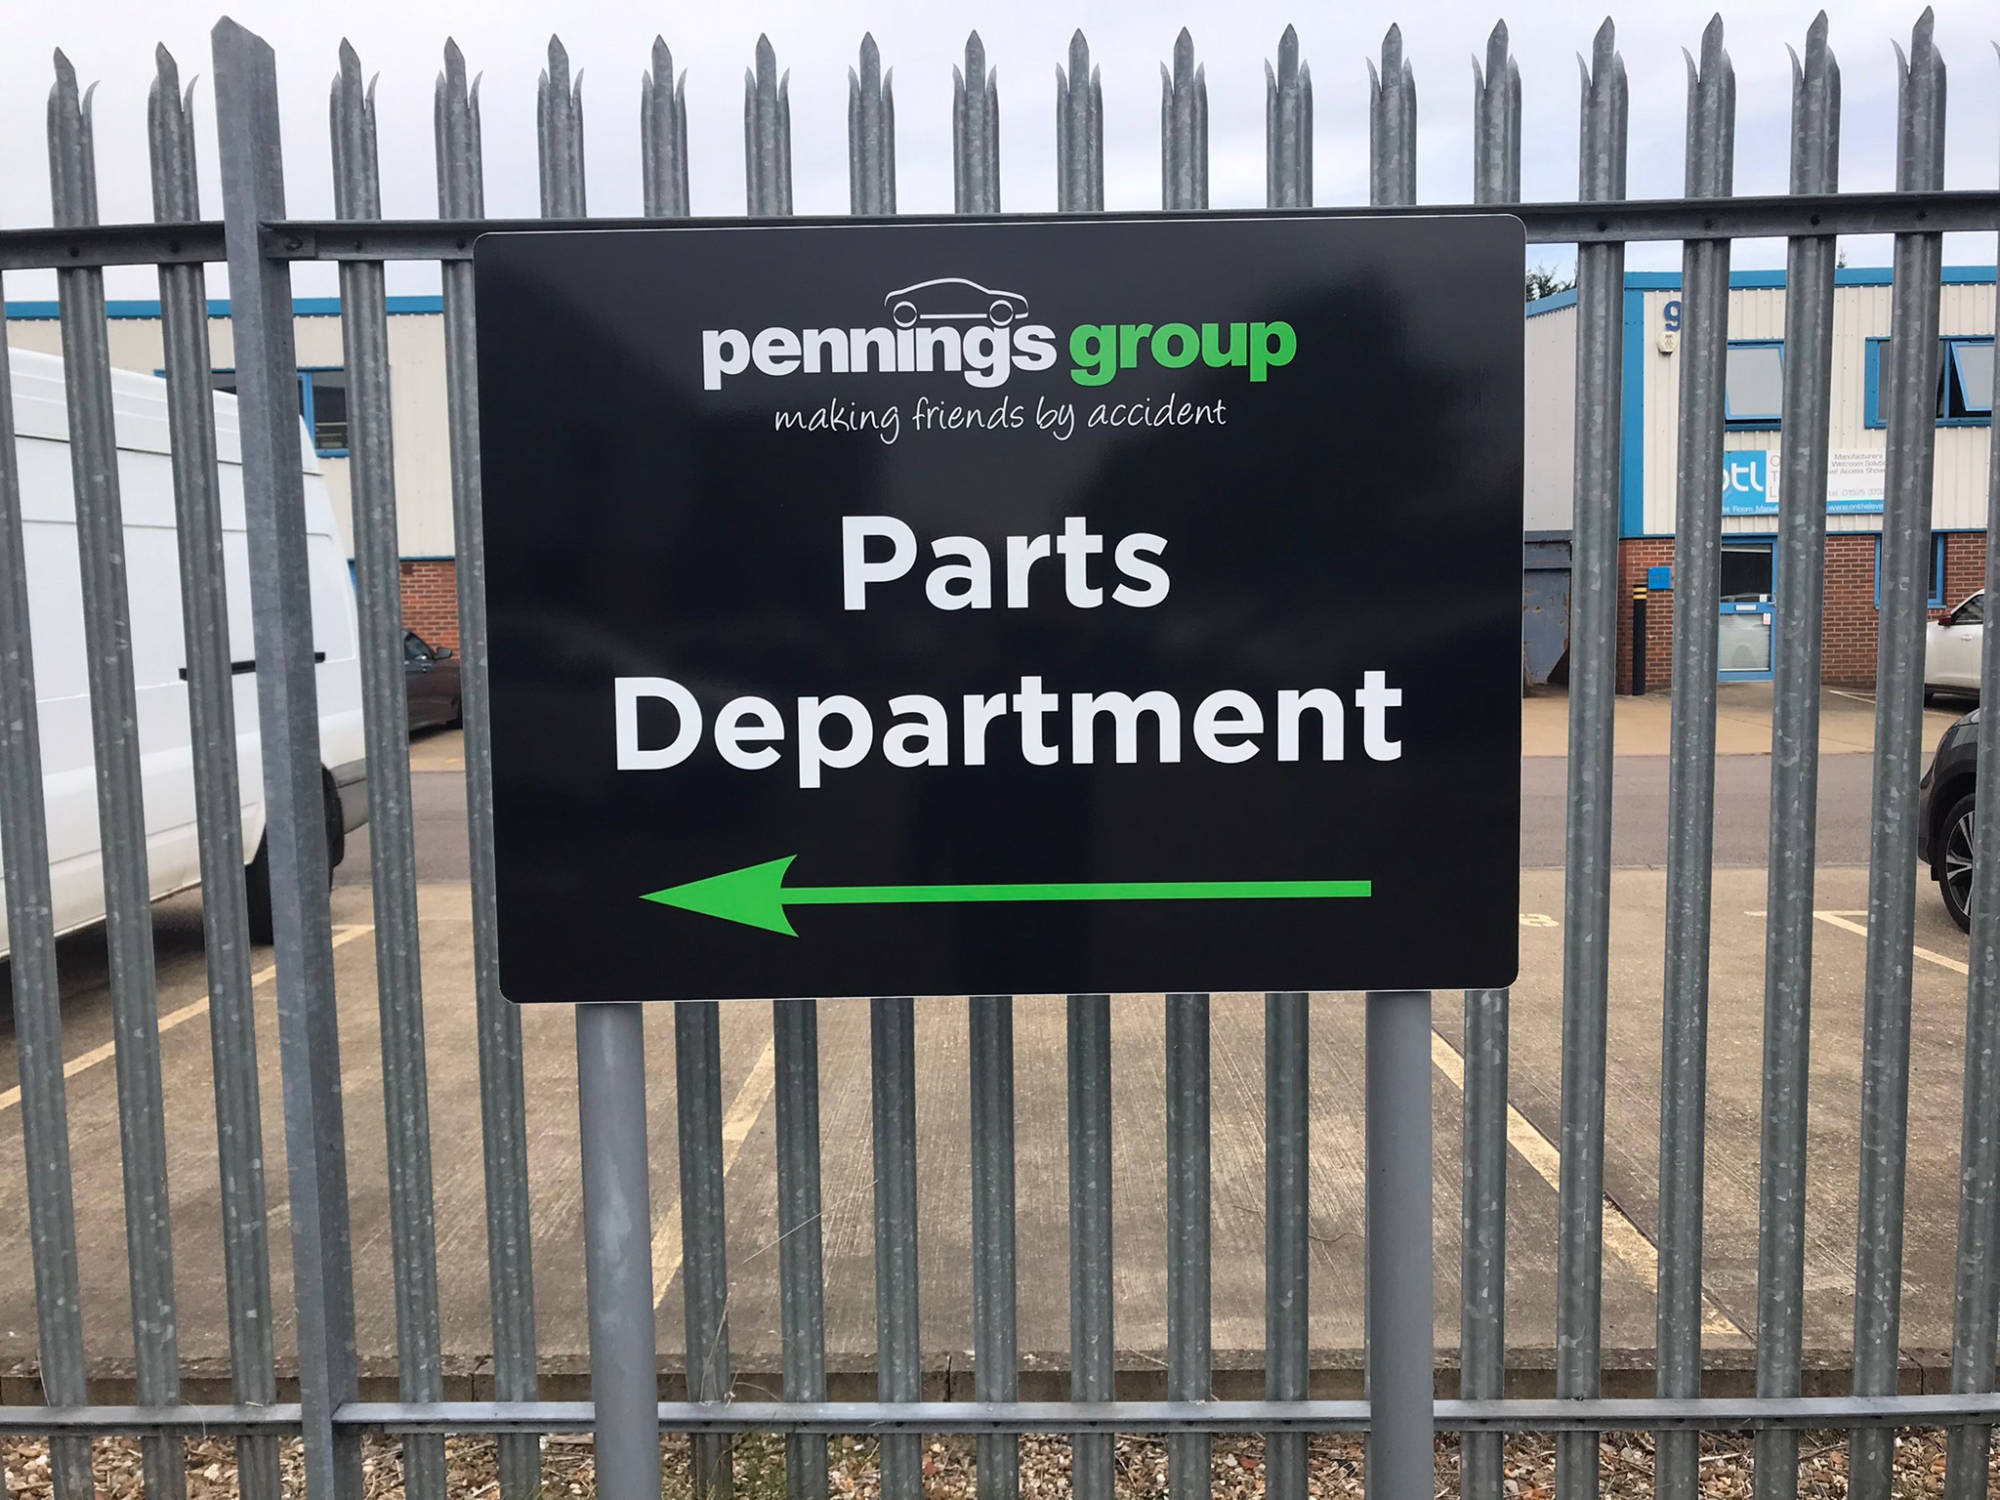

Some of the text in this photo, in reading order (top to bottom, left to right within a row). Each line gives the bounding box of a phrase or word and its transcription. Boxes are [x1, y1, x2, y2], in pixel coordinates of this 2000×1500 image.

[703, 321, 1298, 390] pennings group
[775, 393, 1227, 444] making friends by accident
[842, 516, 1171, 611] Parts
[614, 670, 1403, 789] Department
